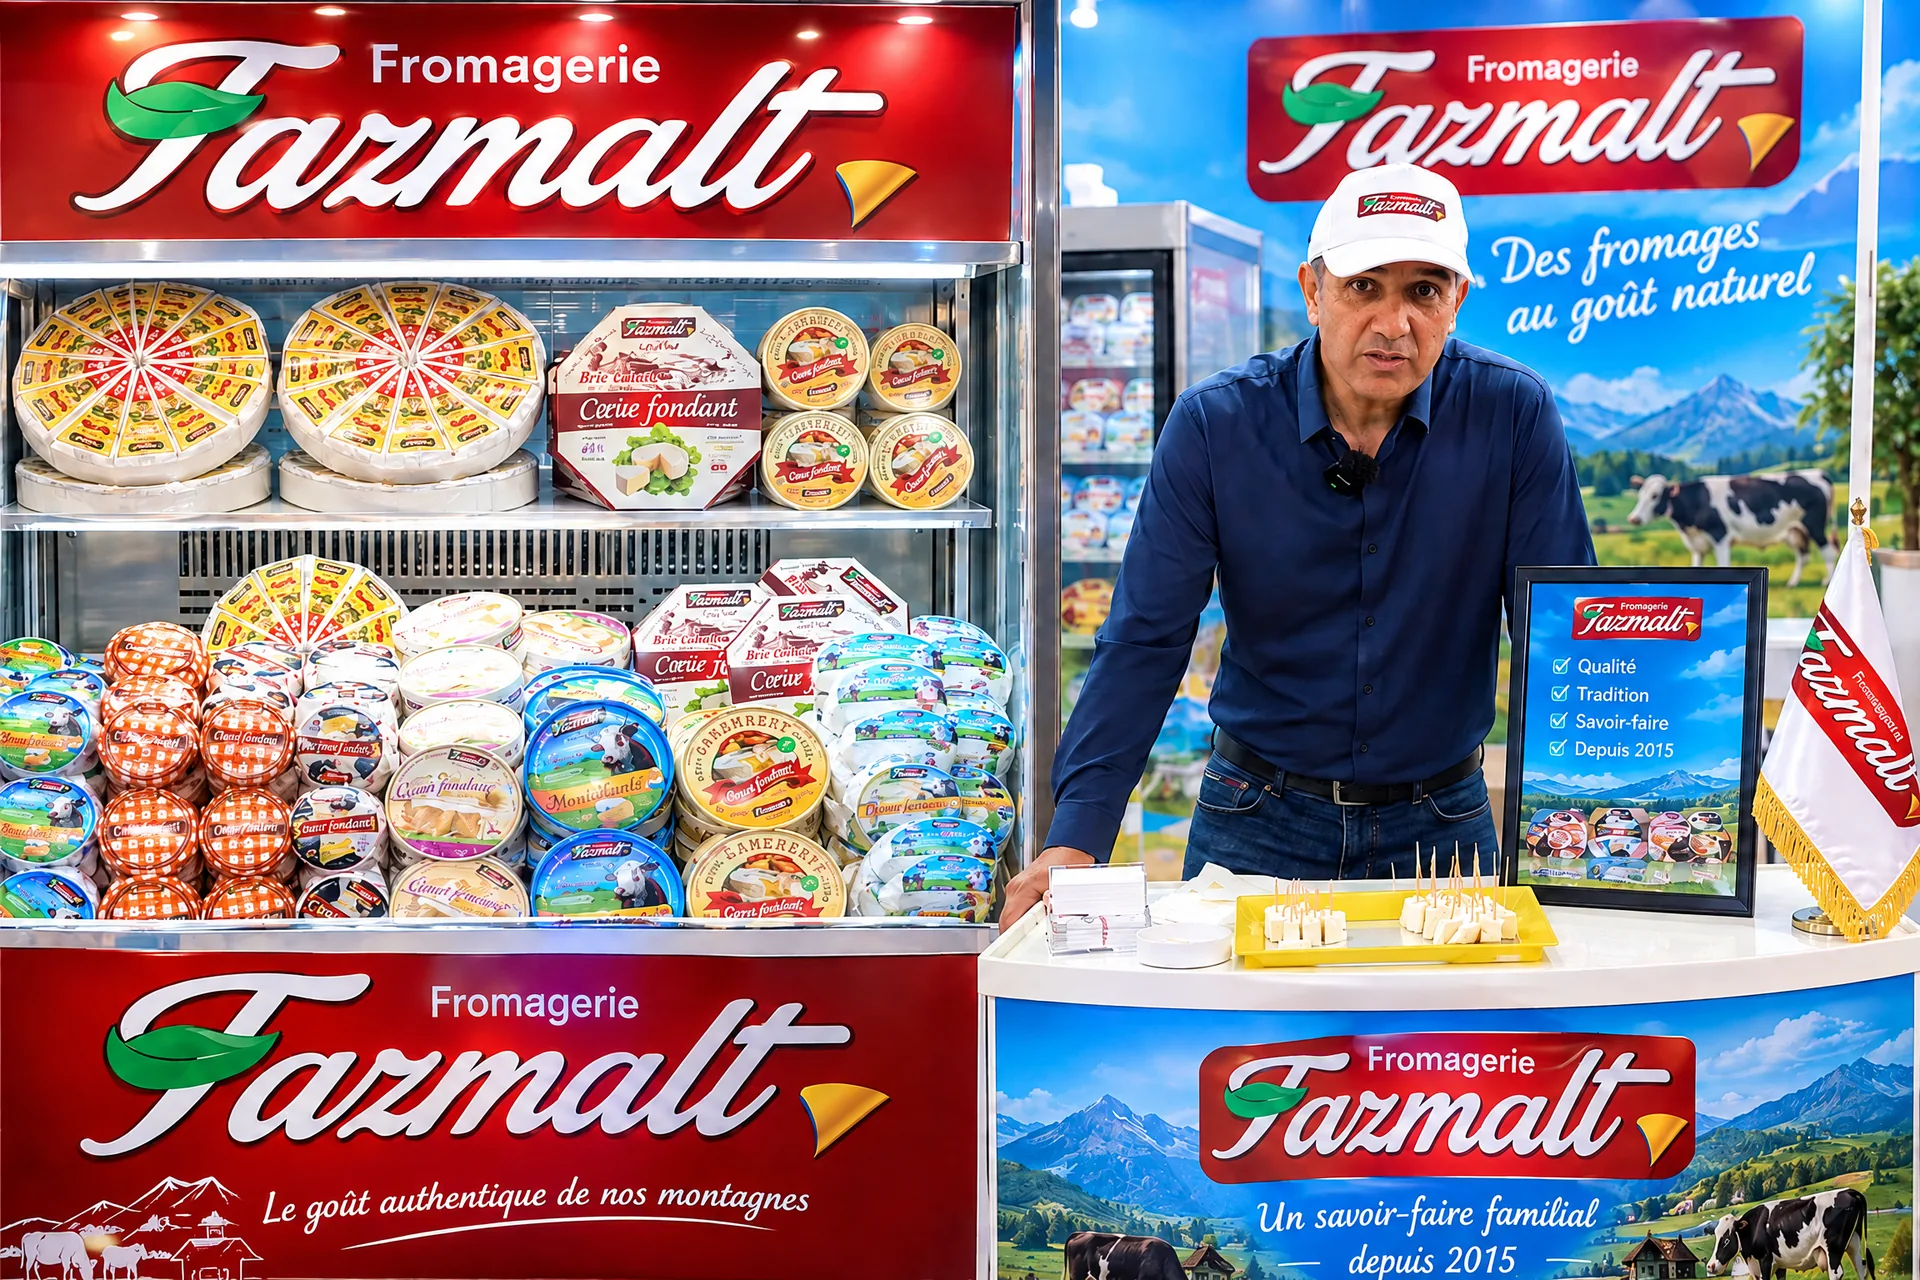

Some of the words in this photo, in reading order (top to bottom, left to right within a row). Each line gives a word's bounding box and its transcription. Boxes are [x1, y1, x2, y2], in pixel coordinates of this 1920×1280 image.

[372, 44, 661, 93] Fromagerie
[1467, 50, 1638, 87] Fromagerie
[1491, 236, 1571, 284] Des
[1581, 220, 1760, 287] fromages
[1506, 302, 1557, 335] au
[1567, 277, 1659, 344] goût
[1671, 251, 1816, 311] naturel
[579, 371, 609, 384] Brie
[640, 393, 739, 427] fondant
[1620, 602, 1669, 612] Fromagerie
[653, 635, 677, 645] Brie
[1578, 658, 1637, 675] Qualité
[1577, 686, 1649, 702] Tradition
[1576, 713, 1669, 731] Savoir-faire
[1575, 741, 1629, 760] Depuis
[1635, 742, 1675, 758] 2015
[430, 985, 639, 1026] Fromagerie
[1367, 1045, 1536, 1077] Fromagerie
[262, 1190, 296, 1225] Le
[303, 1189, 370, 1235] goût
[380, 1181, 547, 1219] authentique
[557, 1175, 590, 1206] de
[600, 1186, 647, 1206] nos
[657, 1183, 810, 1221] montagnes
[1256, 1201, 1305, 1233] Un
[1314, 1194, 1474, 1238] savoir-faire
[1481, 1194, 1600, 1238] familial
[1349, 1243, 1434, 1280] depuis
[1445, 1246, 1517, 1275] 2015
